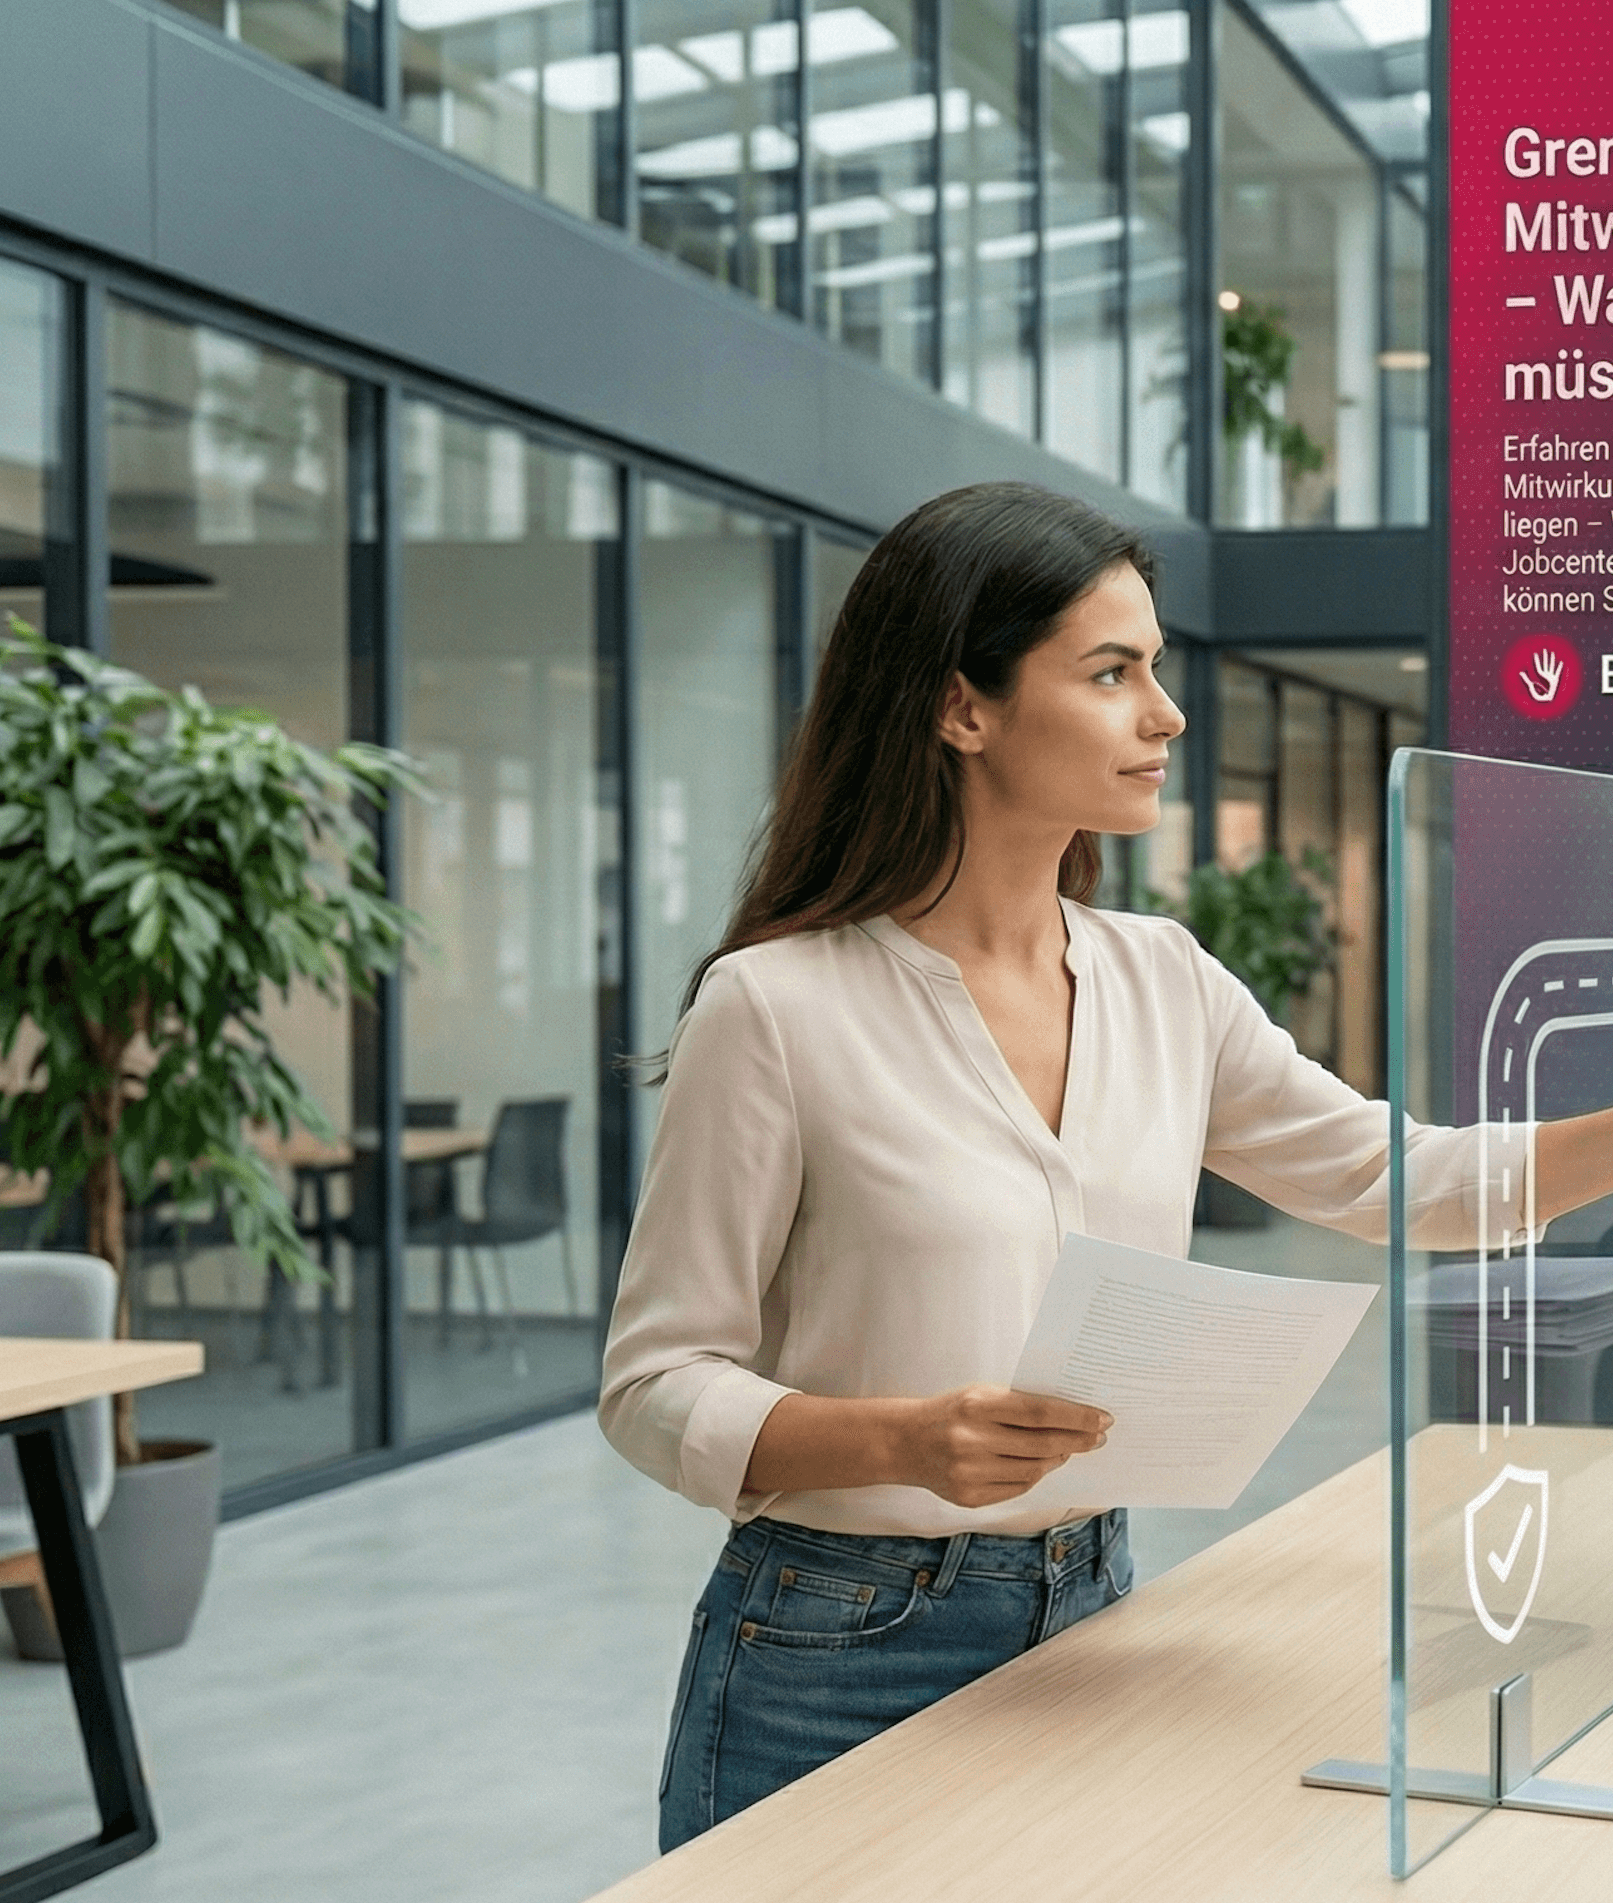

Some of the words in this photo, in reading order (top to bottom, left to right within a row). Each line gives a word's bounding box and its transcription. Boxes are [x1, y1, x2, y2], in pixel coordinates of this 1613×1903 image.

[1503, 433, 1610, 462] Erfahren
[1503, 509, 1578, 542] liegen
[1503, 584, 1595, 613] können
